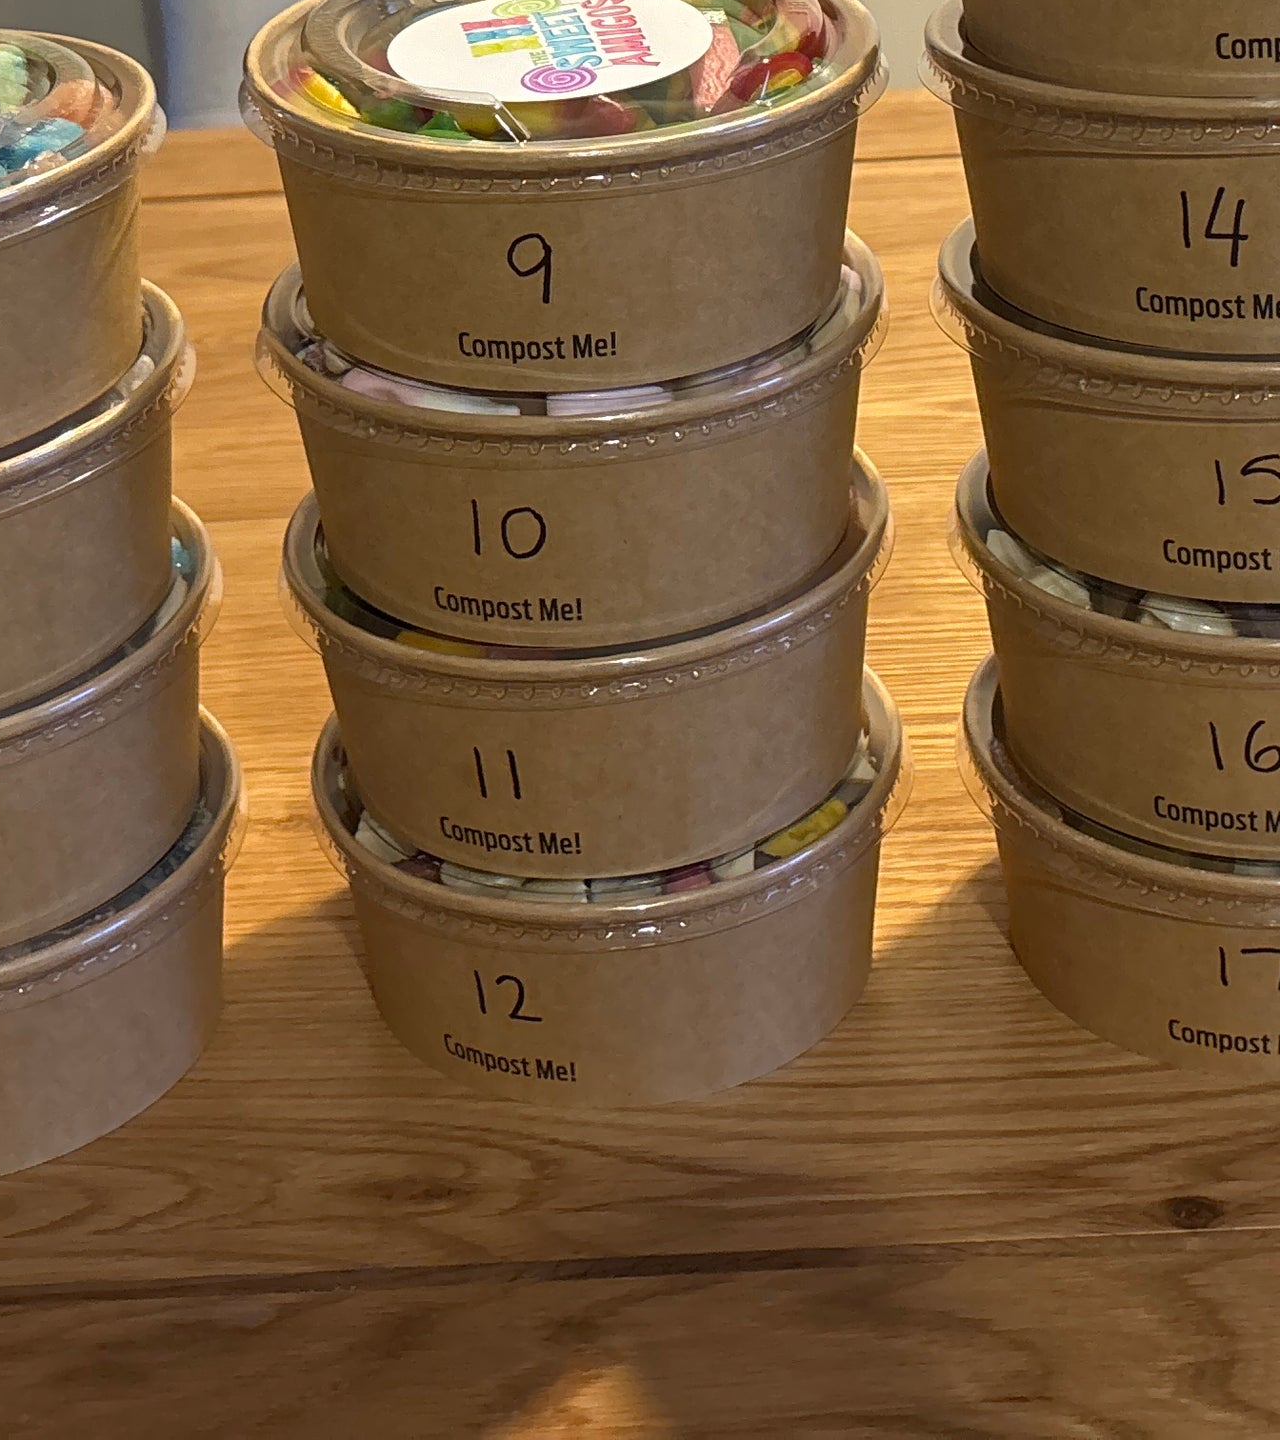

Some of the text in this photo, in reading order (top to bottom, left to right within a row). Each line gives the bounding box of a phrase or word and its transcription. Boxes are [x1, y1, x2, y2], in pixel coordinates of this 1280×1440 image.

[536, 8, 602, 70] SWEET
[1180, 186, 1249, 268] 14
[507, 233, 552, 304] 9
[1135, 286, 1246, 322] Compost
[458, 331, 617, 364] Compost Me!
[471, 498, 547, 559] 10
[1162, 538, 1273, 573] Compost
[434, 586, 583, 622] Compost Me!
[473, 746, 522, 800] 11
[439, 816, 582, 855] Compost Me!
[1153, 795, 1258, 832] Compost
[473, 969, 543, 1023] 12
[443, 1033, 577, 1082] Compost Me!
[1168, 1019, 1271, 1055] Compost
